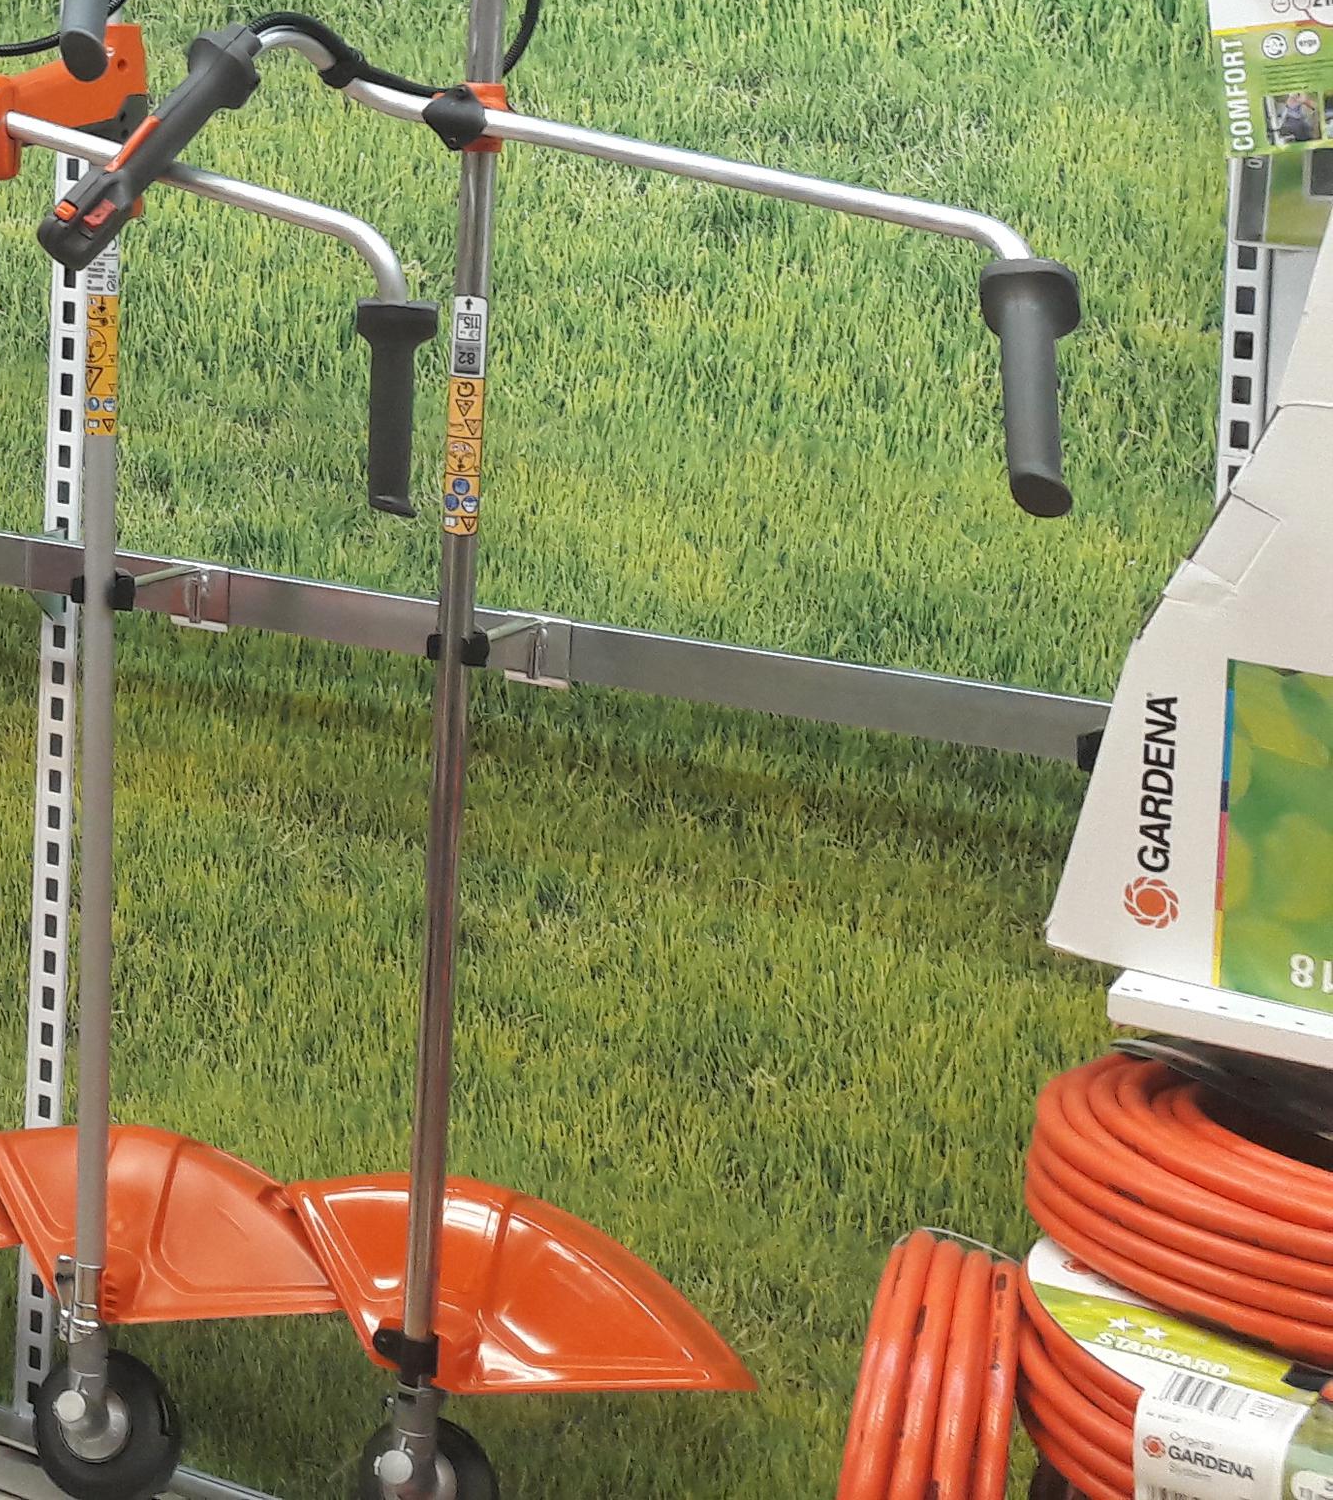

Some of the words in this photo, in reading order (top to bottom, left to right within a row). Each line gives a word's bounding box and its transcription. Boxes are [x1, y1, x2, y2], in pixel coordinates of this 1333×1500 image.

[1220, 38, 1255, 153] COMFORT
[1137, 696, 1178, 873] GARDENA
[1094, 1330, 1231, 1378] STANDARD
[1168, 1445, 1255, 1481] GARDENA
